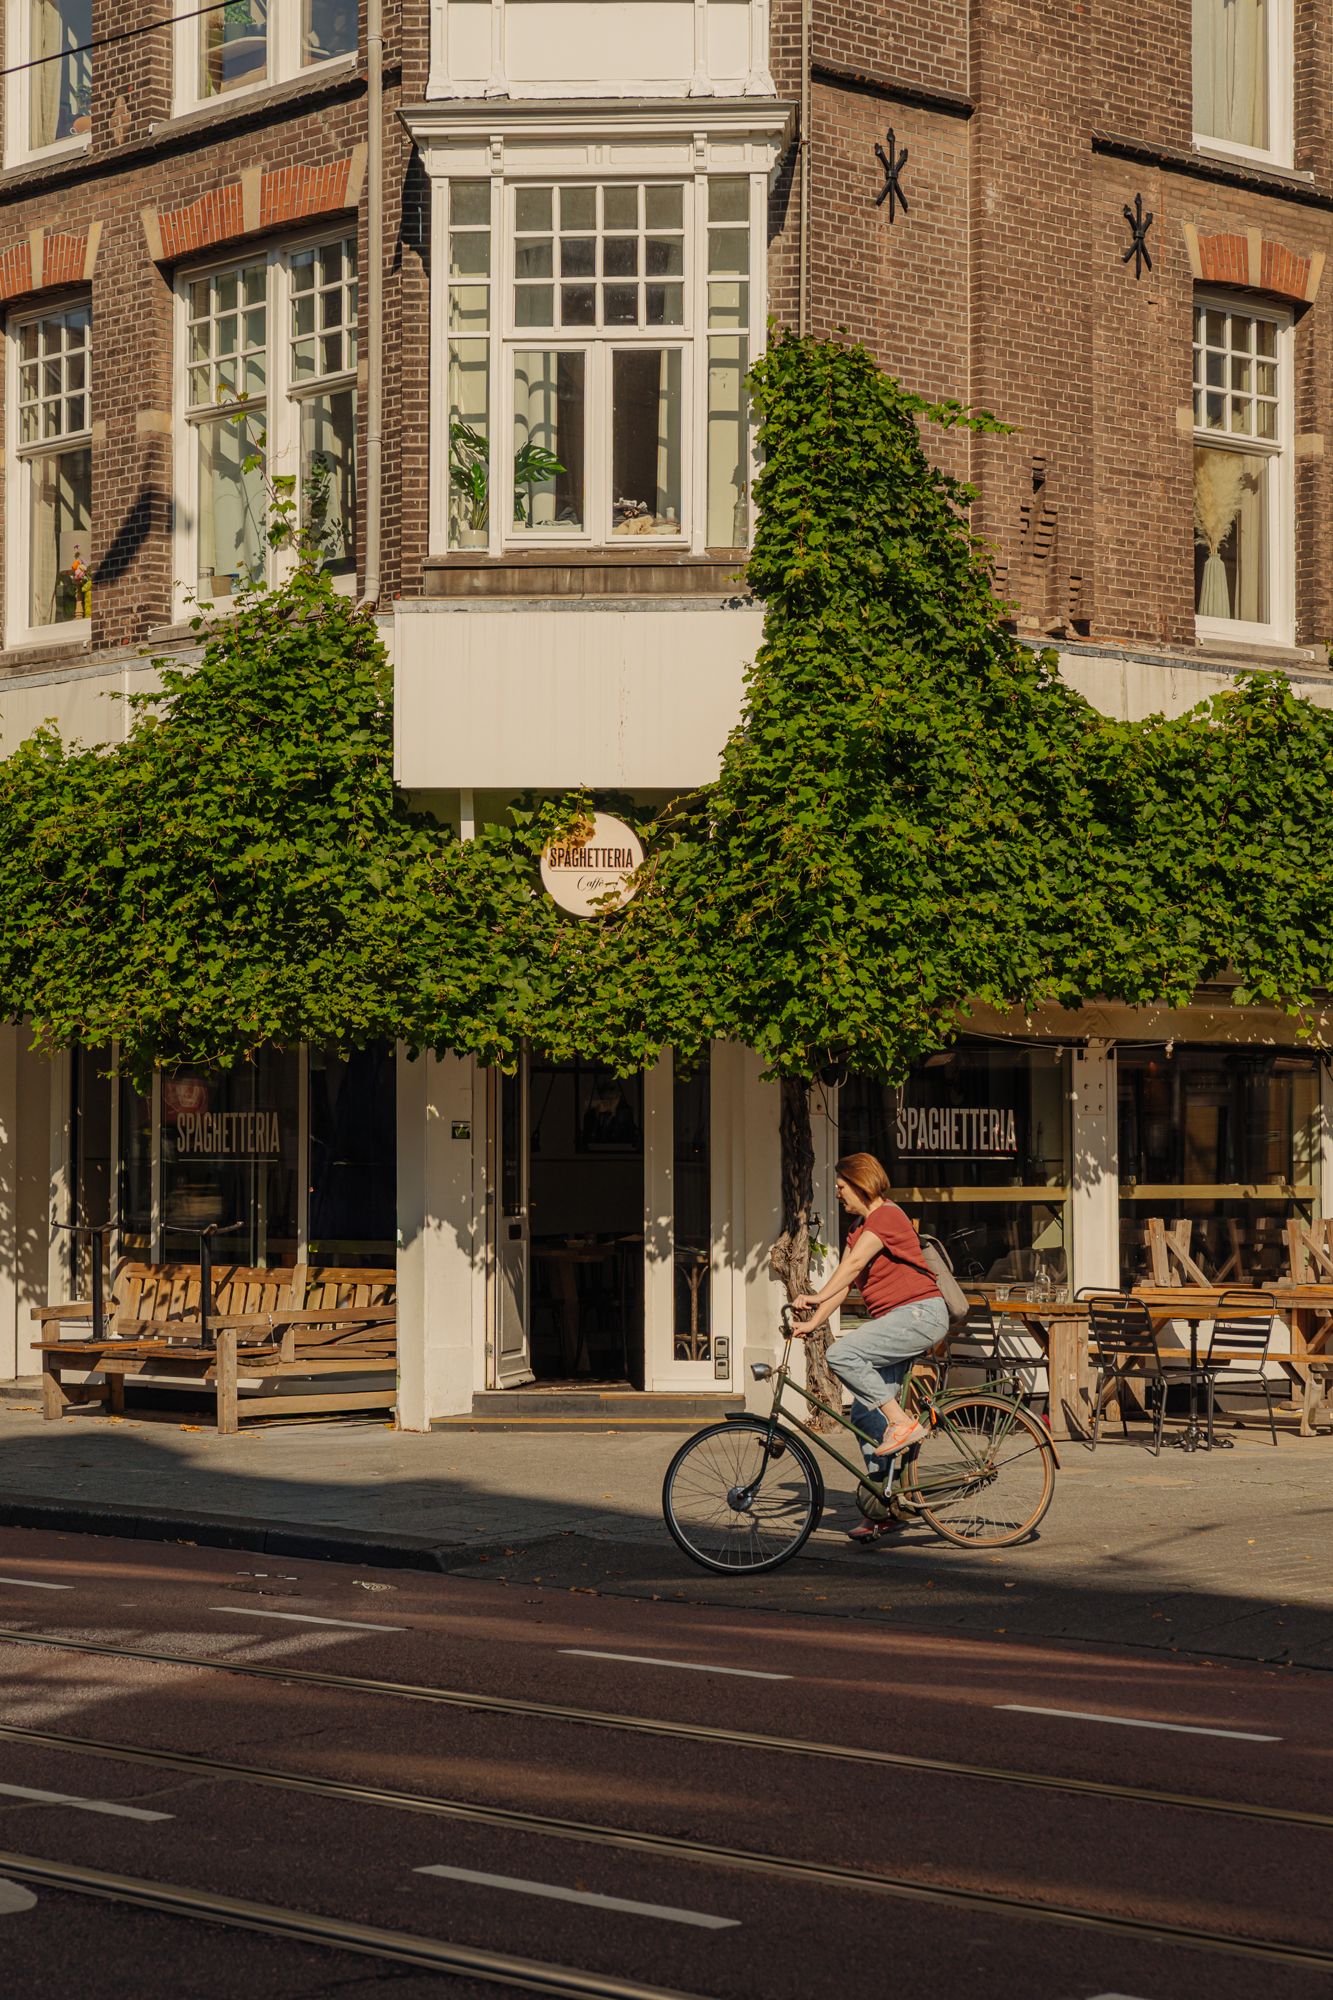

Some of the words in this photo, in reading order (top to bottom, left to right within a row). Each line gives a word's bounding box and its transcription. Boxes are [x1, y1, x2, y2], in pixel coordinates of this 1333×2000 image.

[549, 847, 634, 868] SPAGHETTERIA
[177, 1112, 280, 1153] SPAGHETTERIA
[896, 1107, 1018, 1151] SPAGHETTERIA
